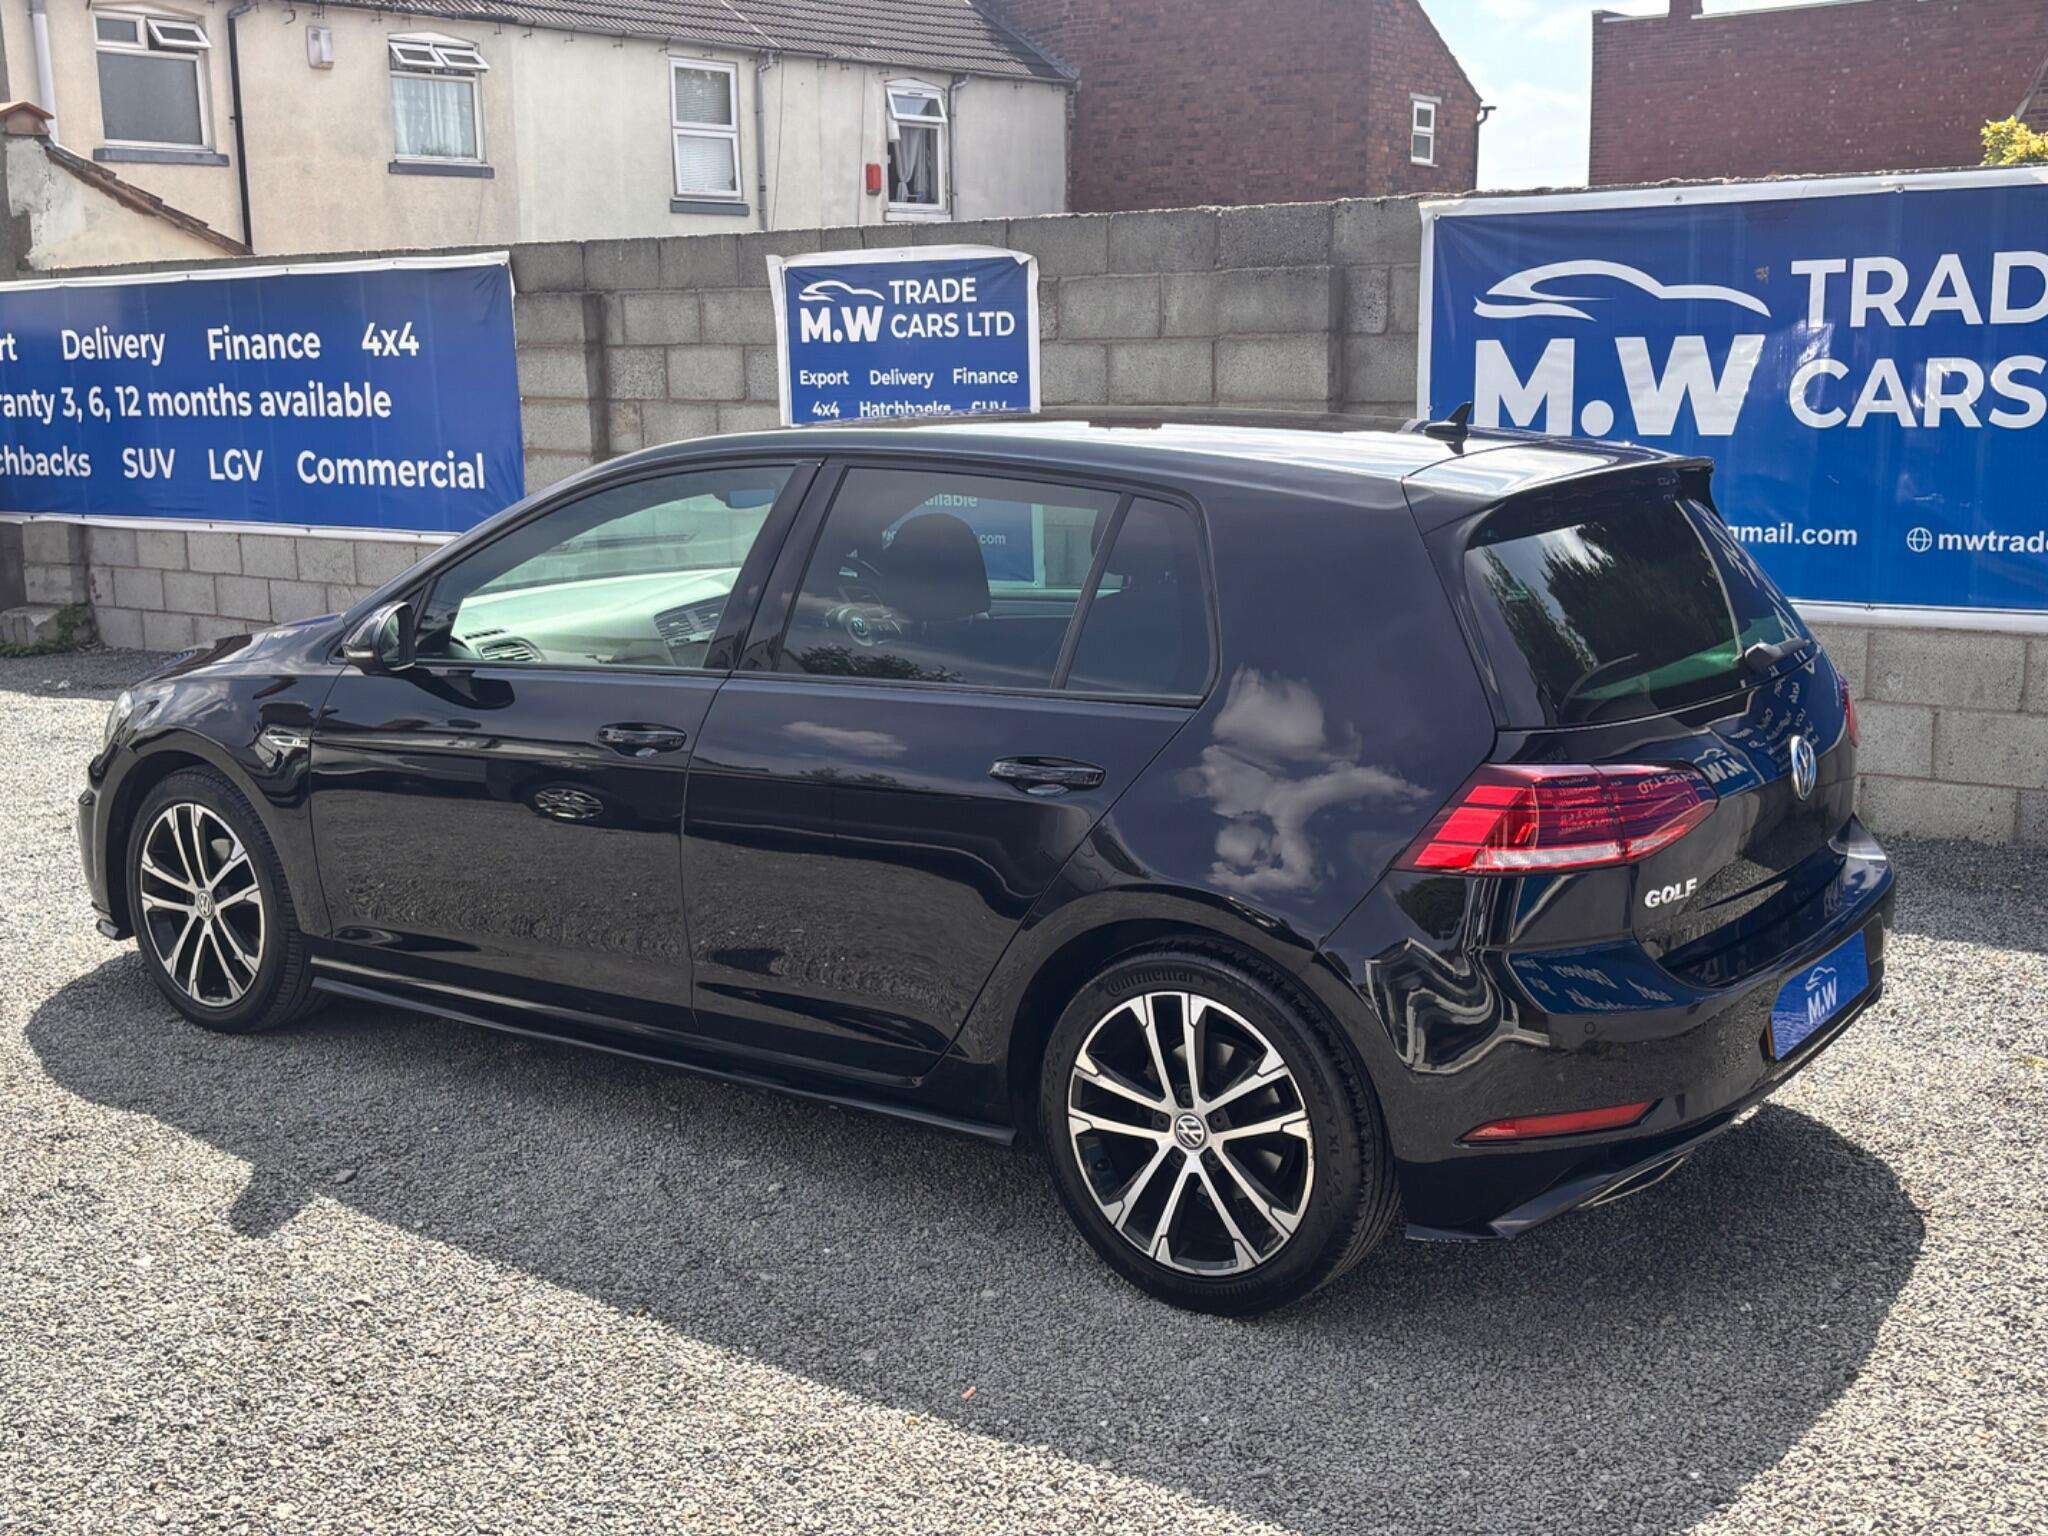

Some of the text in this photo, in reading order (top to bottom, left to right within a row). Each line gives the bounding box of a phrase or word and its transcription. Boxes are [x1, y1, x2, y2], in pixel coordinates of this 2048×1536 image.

[888, 277, 977, 304] TRADE
[1791, 250, 2048, 328] TRAD
[800, 305, 884, 343] M.W
[890, 311, 1015, 338] CARS LTD
[61, 325, 166, 366] Delivery
[207, 325, 321, 361] Finance
[361, 322, 420, 357] 4x4
[799, 366, 1019, 389] Export Delivery Finance
[1474, 333, 1765, 437] M.W
[1788, 354, 2047, 429] CARS
[61, 386, 83, 423] 3,
[88, 386, 111, 423] 6,
[115, 385, 142, 417] 12
[148, 383, 253, 417] months
[260, 381, 392, 418] available
[812, 401, 840, 418] 4x4
[123, 448, 175, 479] SUV
[209, 449, 263, 482] LGV
[296, 450, 485, 489] Commercial
[1644, 877, 1698, 908] GOLF
